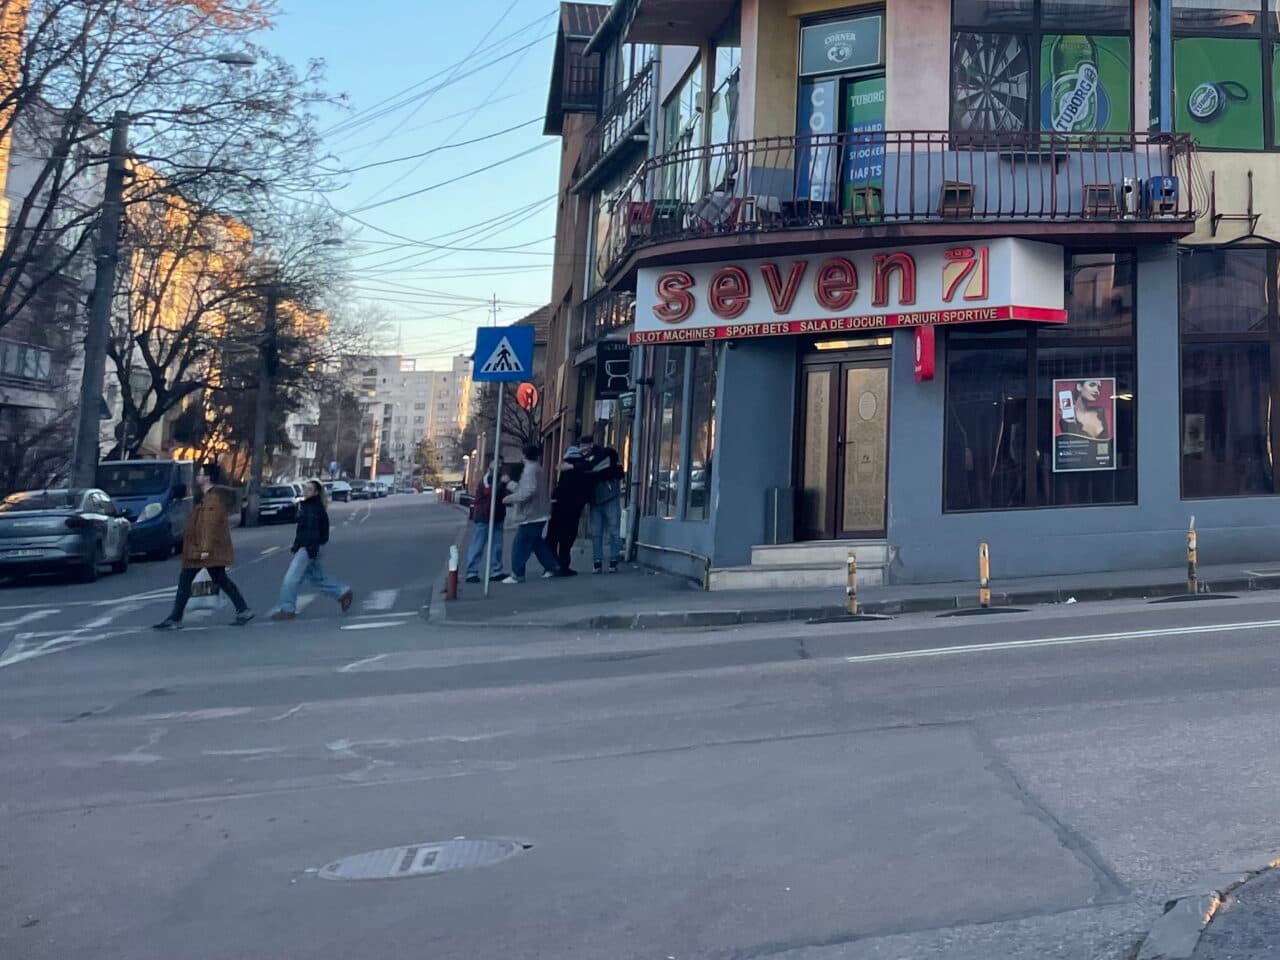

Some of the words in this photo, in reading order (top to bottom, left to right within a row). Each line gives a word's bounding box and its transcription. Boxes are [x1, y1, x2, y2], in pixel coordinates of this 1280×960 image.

[851, 90, 884, 107] TUBORG
[1056, 78, 1094, 130] TUBORG
[850, 165, 882, 180] DARTS
[652, 251, 916, 323] seven
[636, 332, 661, 343] SLOT
[664, 327, 715, 340] MACHINES
[726, 324, 759, 337] SPORT
[763, 323, 789, 335] BETS
[800, 320, 828, 331] SALA
[831, 318, 844, 329] DE
[847, 316, 887, 328] JOCURI
[898, 312, 940, 324] PARIURI
[943, 309, 997, 322] SPORTIVE
